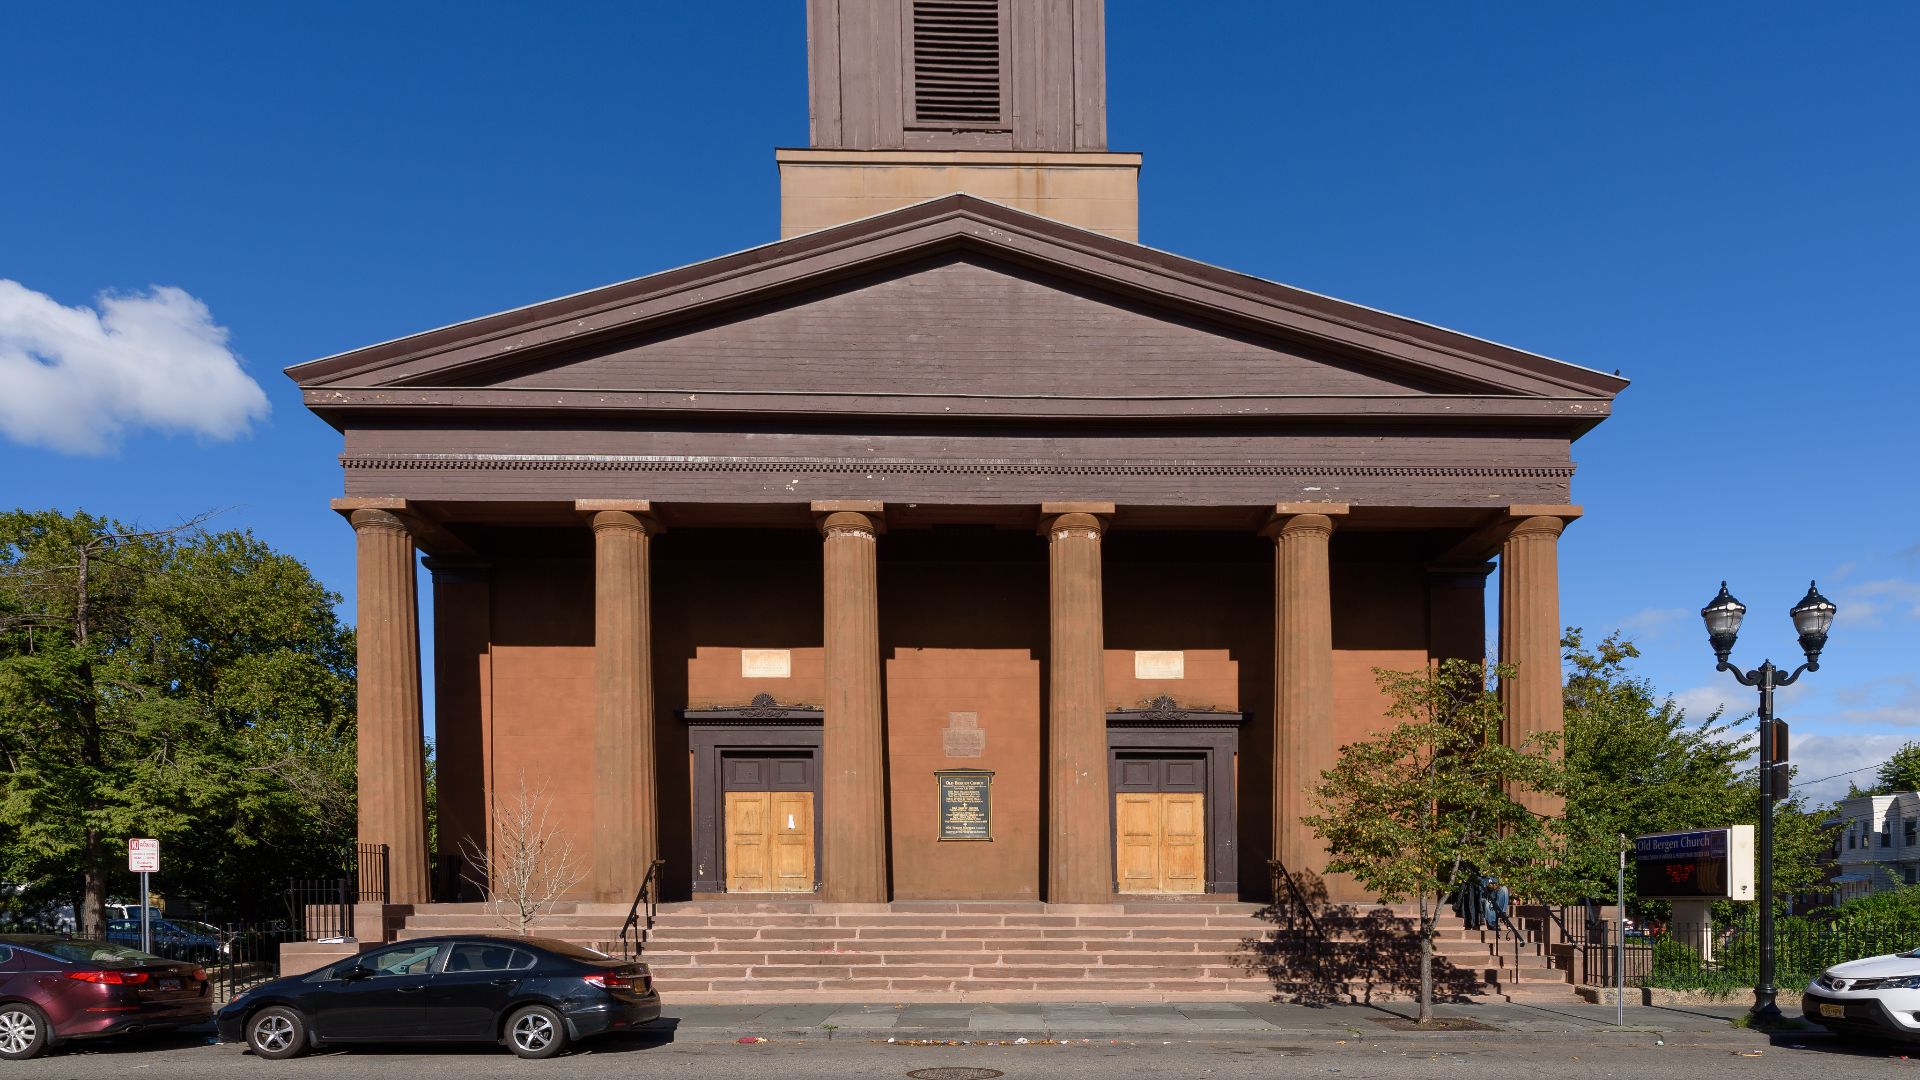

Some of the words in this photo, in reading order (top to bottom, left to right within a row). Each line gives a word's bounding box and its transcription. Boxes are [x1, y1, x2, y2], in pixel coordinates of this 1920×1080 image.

[131, 840, 139, 849] NO
[1637, 840, 1651, 851] Old
[1653, 839, 1678, 852] Bergen
[1680, 834, 1710, 848] Church
